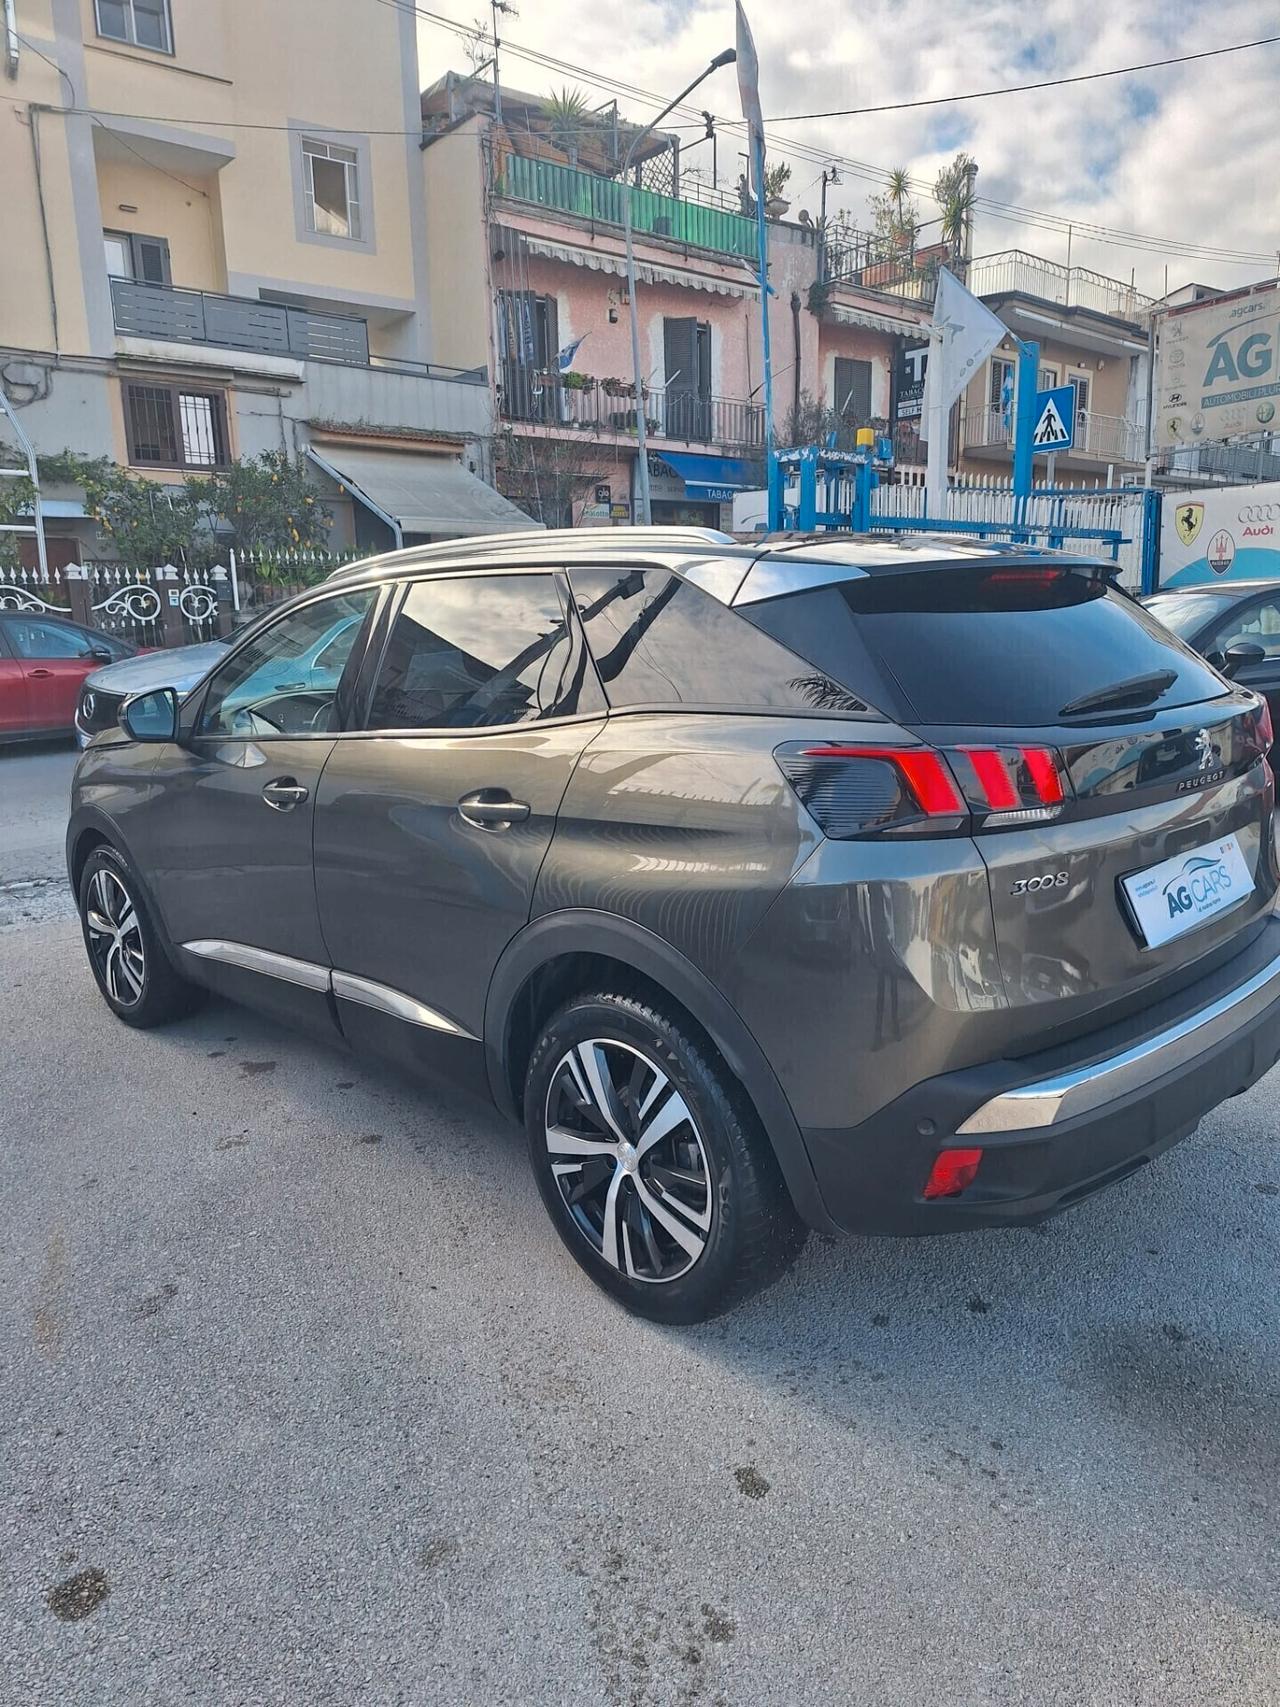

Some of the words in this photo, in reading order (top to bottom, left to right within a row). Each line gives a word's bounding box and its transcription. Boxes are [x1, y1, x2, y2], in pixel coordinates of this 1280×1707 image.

[1202, 333, 1273, 388] AG
[648, 463, 678, 478] ABAC
[1242, 525, 1274, 537] Audi
[1179, 770, 1224, 791] PEUGEOT
[1011, 871, 1069, 896] 3008
[1166, 886, 1193, 919] AG
[1191, 865, 1232, 903] CARS
